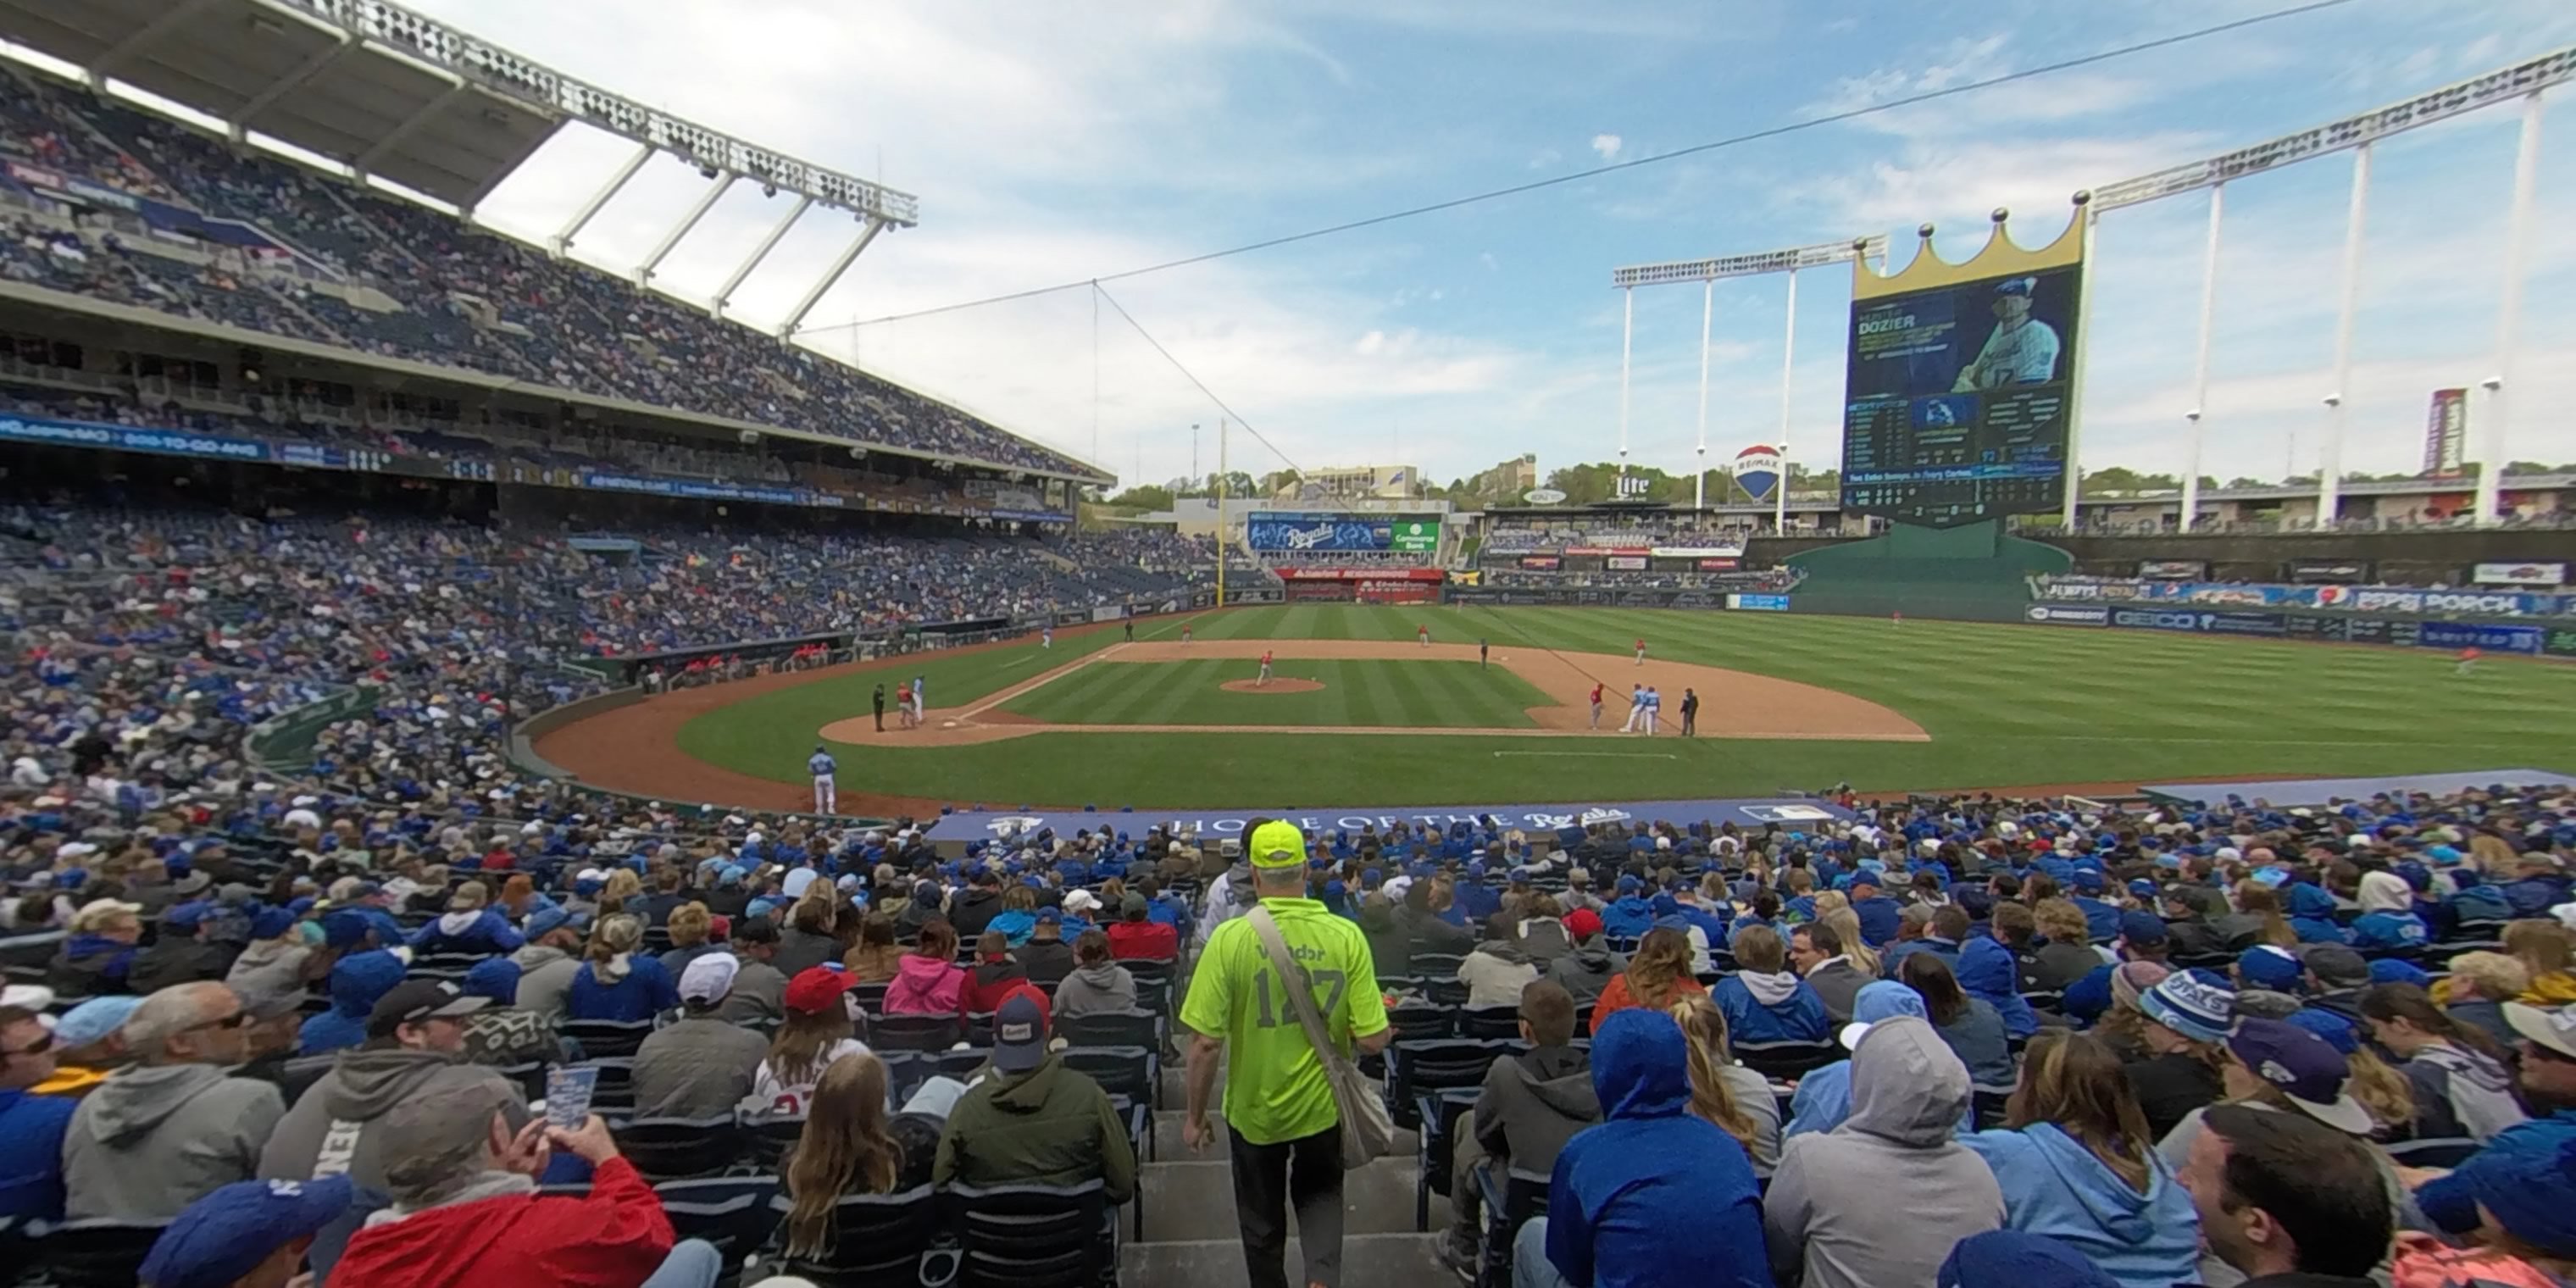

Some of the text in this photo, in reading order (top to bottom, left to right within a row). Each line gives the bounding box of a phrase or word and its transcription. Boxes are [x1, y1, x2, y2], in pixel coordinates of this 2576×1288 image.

[1858, 314, 1915, 335] DOZIER
[1738, 458, 1779, 470] RE/MAX
[1615, 476, 1650, 497] Lite
[1287, 522, 1335, 549] Royals
[1395, 533, 1435, 543] Commerce
[2358, 591, 2518, 613] PEPSI PORCH
[2115, 610, 2198, 629] GEICO
[1173, 817, 1323, 833] HOE
[1337, 815, 1397, 829] OF
[1413, 813, 1514, 828] THE
